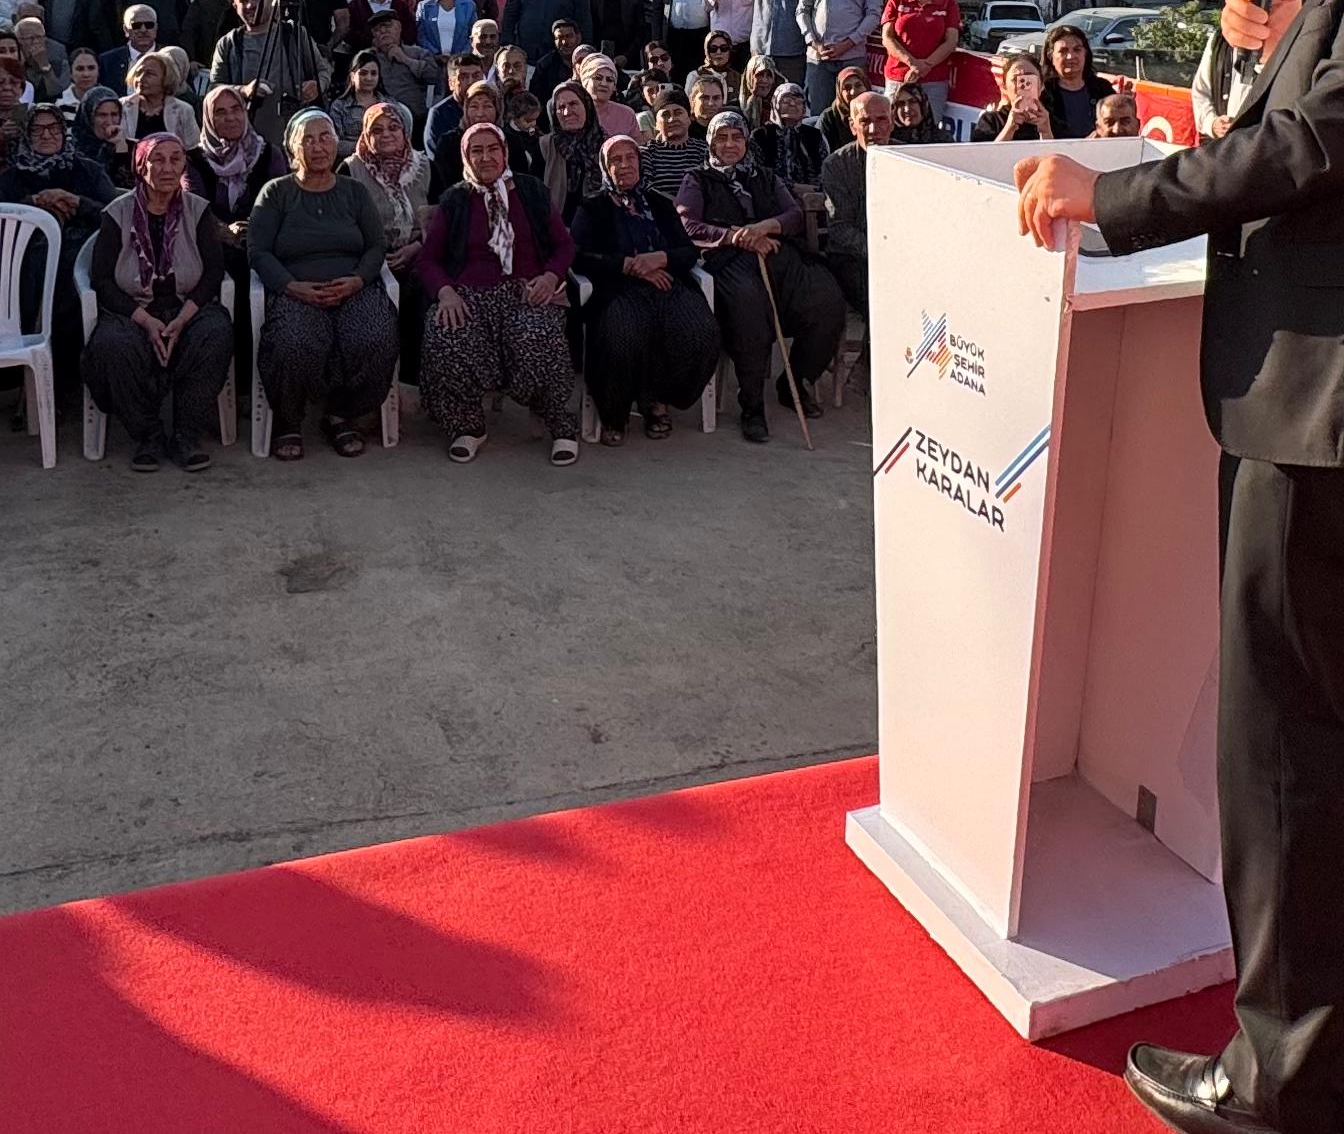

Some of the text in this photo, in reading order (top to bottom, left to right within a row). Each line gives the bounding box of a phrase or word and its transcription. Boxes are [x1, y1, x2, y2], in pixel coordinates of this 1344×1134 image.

[950, 334, 985, 361] BÜYÜK
[953, 353, 985, 378] ŞEHİR
[950, 368, 986, 396] ADANA
[915, 429, 990, 493] ZEYDAN
[916, 457, 1005, 533] KARALAR
